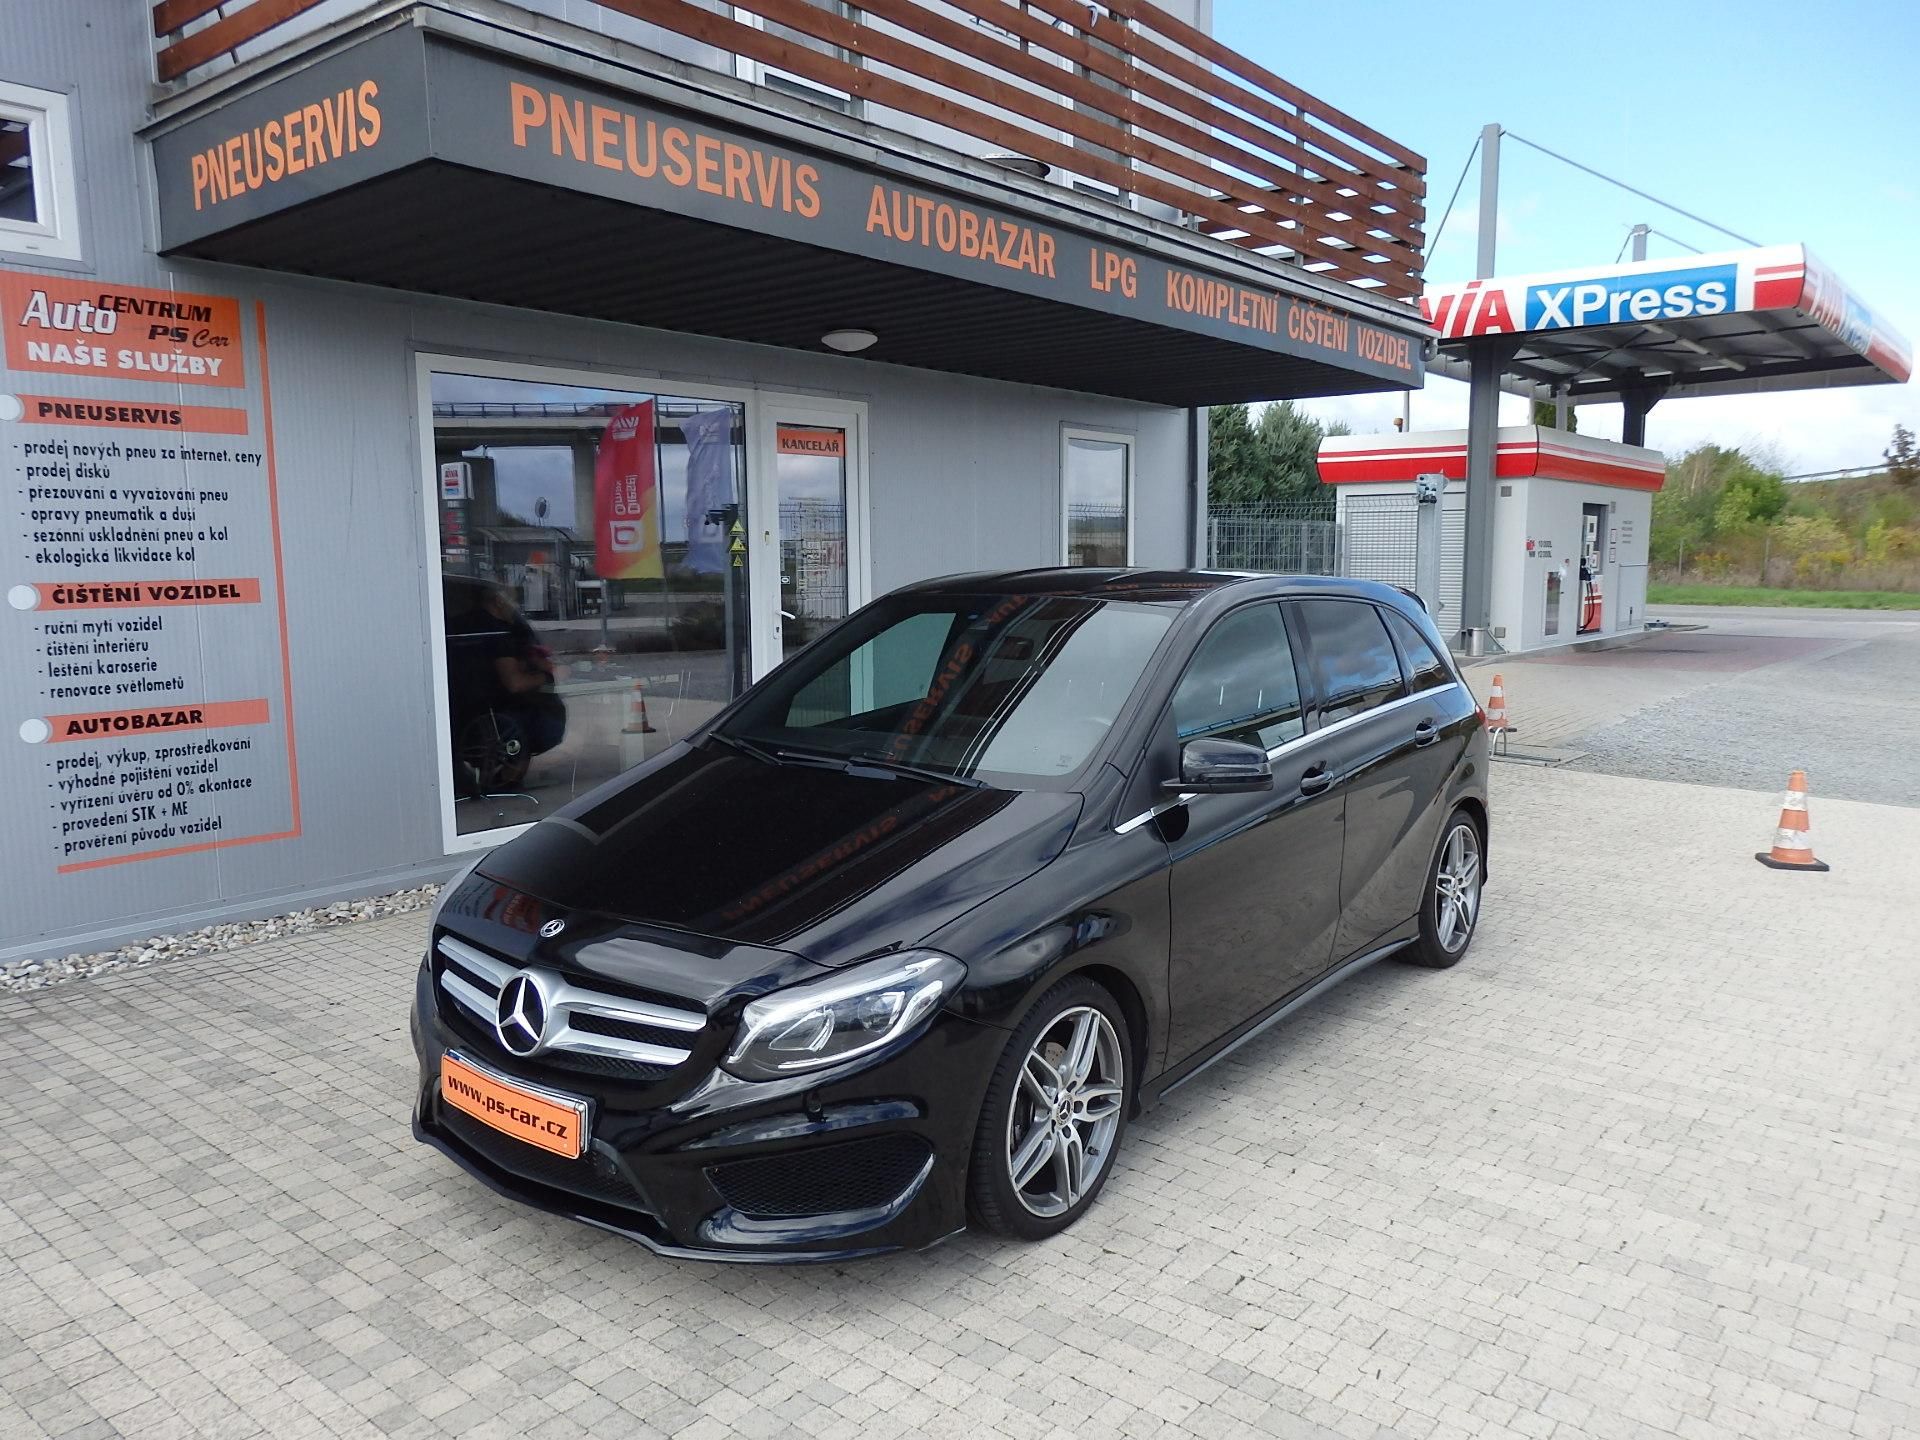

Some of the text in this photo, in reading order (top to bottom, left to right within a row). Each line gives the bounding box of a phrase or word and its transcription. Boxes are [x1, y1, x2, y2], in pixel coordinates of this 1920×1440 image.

[191, 79, 382, 212] PNEUSERVIS
[510, 82, 1413, 371] PNEUSERVIS AUTOBAZAR LPG KOMPLETNÍ ČIŠTĚNÍ VOZIDEL
[20, 289, 212, 335] Auto CENTRUM
[1418, 280, 1728, 339] VIA XPress
[148, 324, 231, 349] PS Car
[27, 338, 224, 377] NAŠE SLUŽBY
[38, 402, 183, 426] PNEUSERVIS
[24, 439, 262, 467] prodej nových pneu za internet. ceny
[781, 437, 839, 454] KANCELÁŘ
[26, 461, 111, 482] prodej disků
[28, 484, 229, 505] přezouvání a vyvažování pneu
[31, 510, 80, 525] opravy
[85, 506, 156, 525] pneumatik
[159, 511, 167, 521] a
[33, 526, 229, 545] sezónní uskladnění pneu a kol
[35, 546, 196, 567] ekologická likvidace kol
[52, 582, 241, 604] ČIŠTĚNÍ VOZIDEL
[44, 622, 78, 636] ruční
[117, 615, 163, 633] vozidel
[46, 637, 149, 657] čištění interiéru
[48, 657, 158, 678] leštění karoserie
[50, 676, 185, 699] renovace světlometů
[66, 709, 204, 736] AUTOBAZAR
[56, 736, 251, 774] prodej, výkup, zprostředkování
[58, 757, 218, 794] výhodné pojištění vozidel
[60, 777, 252, 815] vyřízení úvěru od 0% akontace
[62, 809, 128, 837] provedení
[132, 805, 157, 823] STK
[171, 801, 189, 817] ME
[64, 815, 222, 857] prověření původu vozidel
[447, 1074, 568, 1140] www.ps-car.cz
